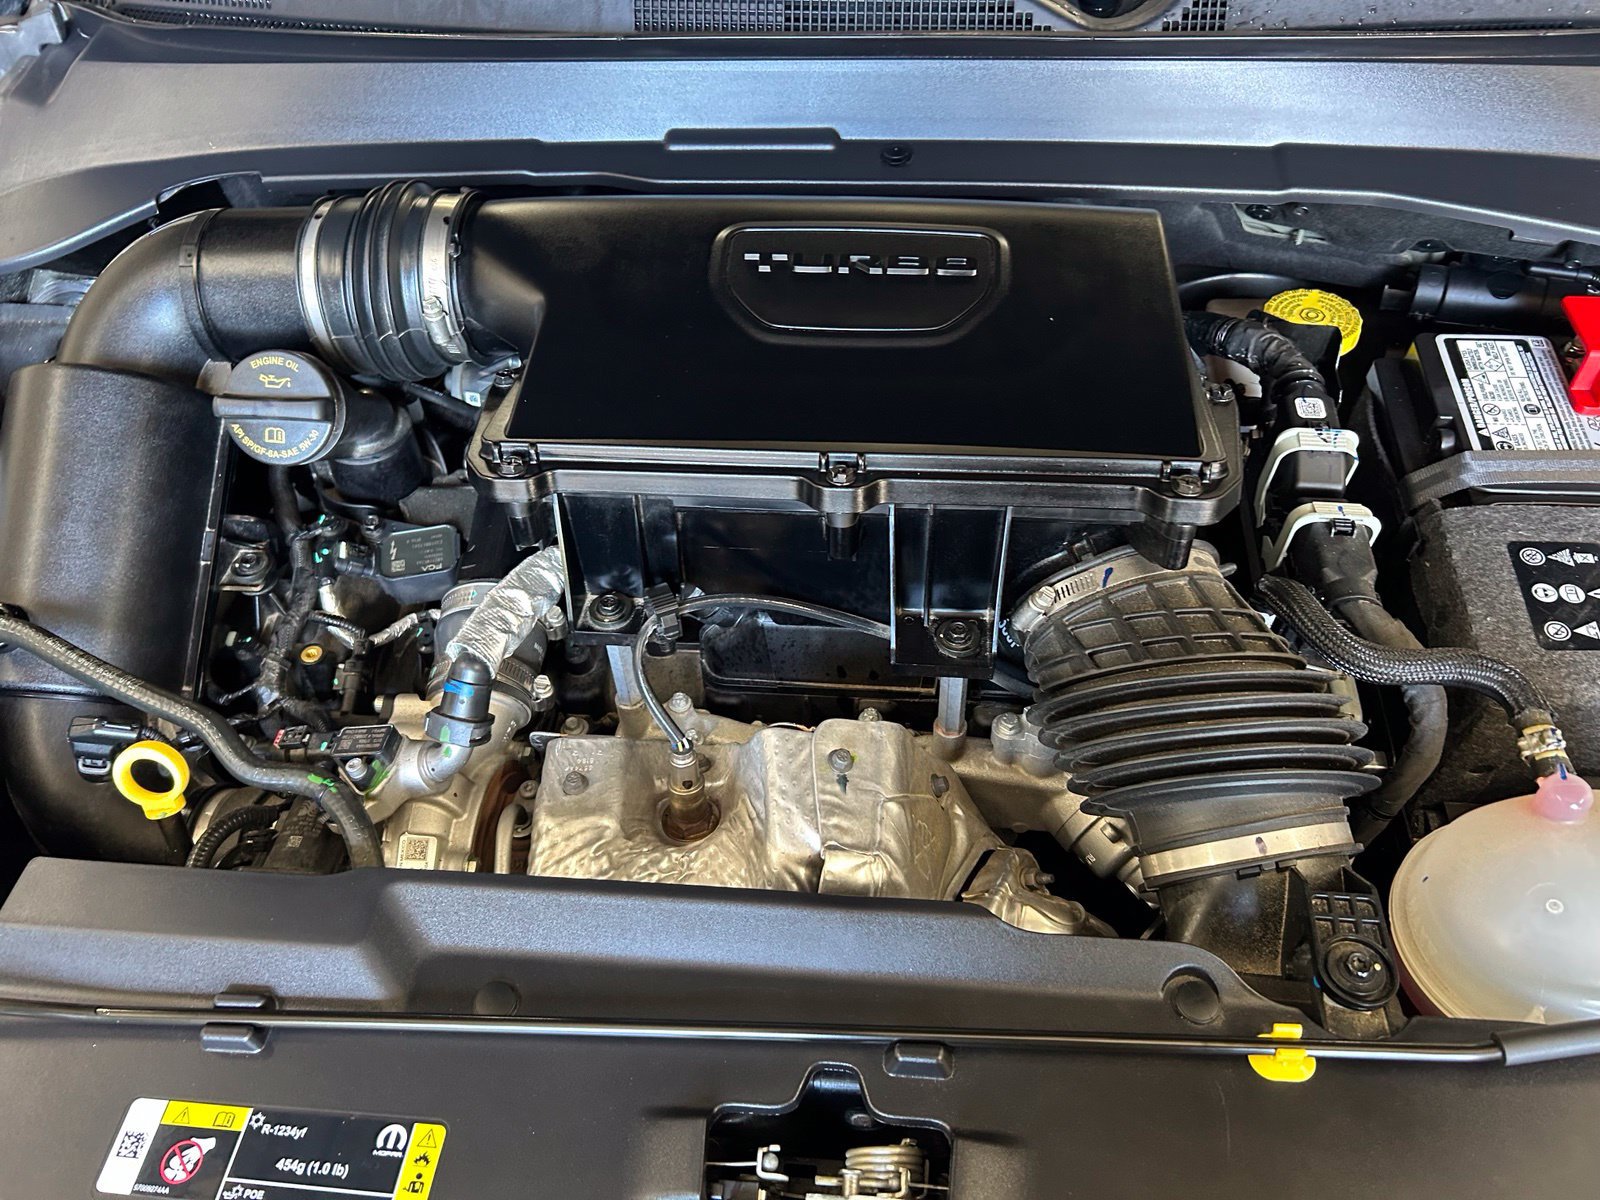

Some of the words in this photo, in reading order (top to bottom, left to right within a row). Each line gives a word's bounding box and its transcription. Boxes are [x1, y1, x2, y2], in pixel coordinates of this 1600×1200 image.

[744, 252, 978, 276] TURBO
[250, 356, 284, 369] ENGINE
[285, 359, 300, 373] OIL
[230, 423, 245, 438] API
[299, 429, 320, 451] 5W-30
[261, 1123, 308, 1139] R-1234yf
[275, 1157, 305, 1177] 454g
[306, 1159, 331, 1177] (1.0
[332, 1161, 349, 1179] lb)
[243, 1189, 265, 1200] POE
